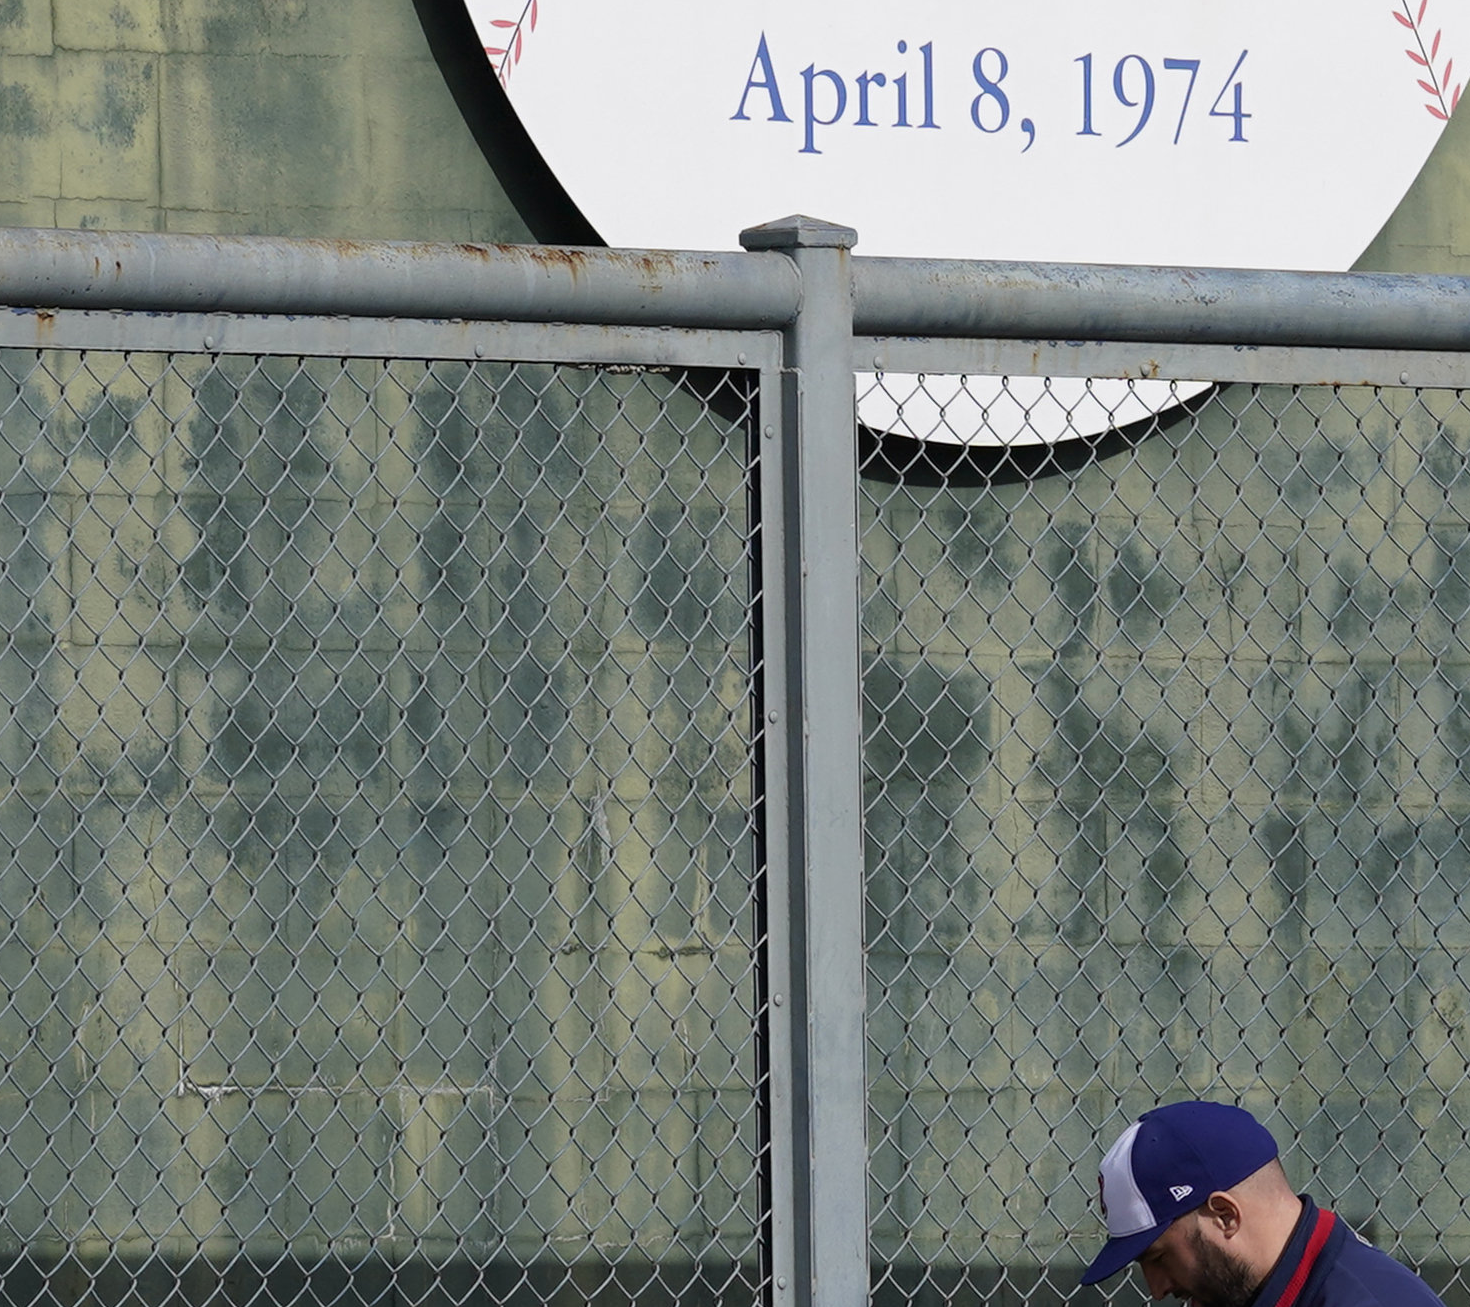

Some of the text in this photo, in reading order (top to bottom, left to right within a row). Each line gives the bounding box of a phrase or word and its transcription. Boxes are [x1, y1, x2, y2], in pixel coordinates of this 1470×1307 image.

[729, 30, 1254, 154] April 8, 1974
